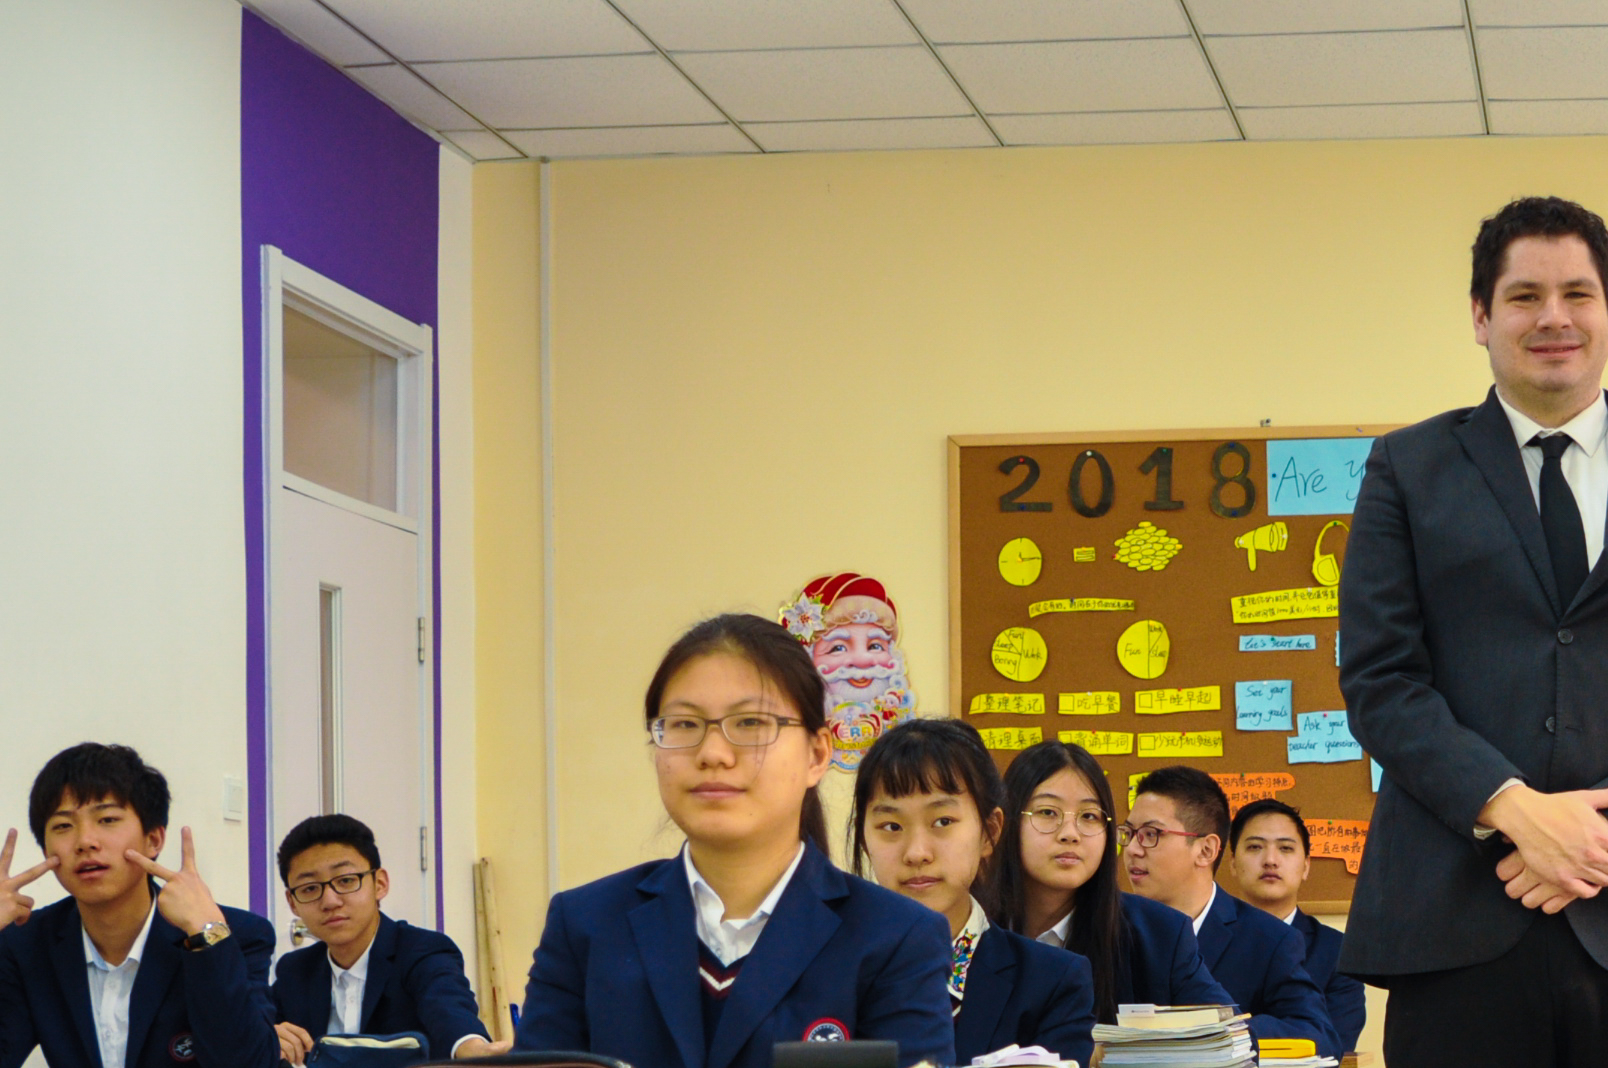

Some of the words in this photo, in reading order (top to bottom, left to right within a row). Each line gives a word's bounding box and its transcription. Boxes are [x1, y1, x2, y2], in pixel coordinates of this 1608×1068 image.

[998, 441, 1256, 519] 2018
[1275, 456, 1327, 502] Are
[1008, 629, 1023, 639] Fun
[1124, 642, 1141, 658] Fun
[1076, 694, 1119, 713] 吃早餐
[1154, 691, 1211, 711] 早睡早起
